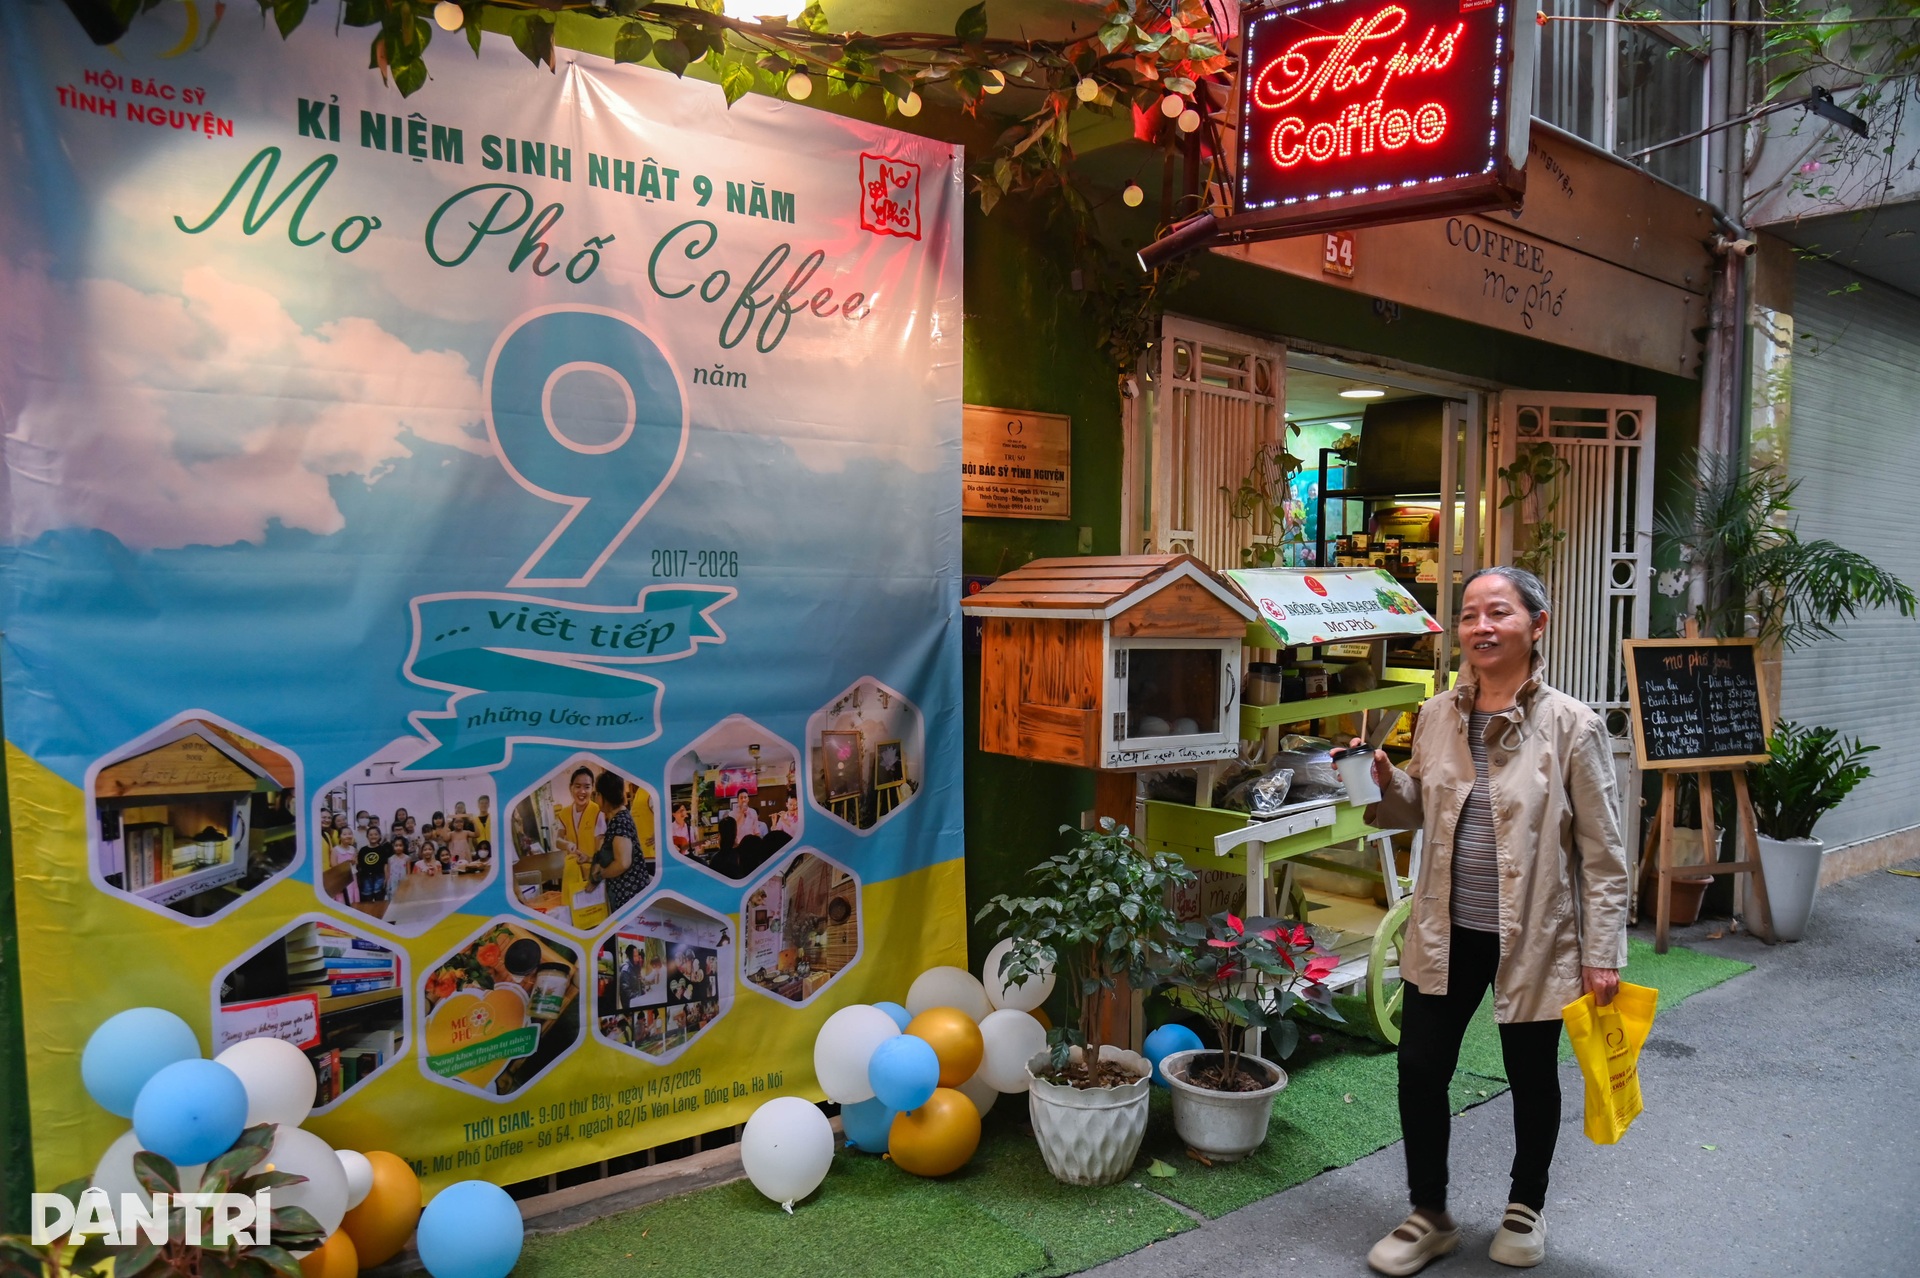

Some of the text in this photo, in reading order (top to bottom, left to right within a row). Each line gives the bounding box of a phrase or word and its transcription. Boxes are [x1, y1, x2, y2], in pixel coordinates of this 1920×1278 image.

[56, 84, 234, 139] TÌNH NGUYỆN
[84, 69, 206, 106] HỘI BÁC SỸ
[1270, 98, 1447, 168] Coffee
[298, 95, 795, 224] KỈ NIỆM SINH NHẬT 9 NĂM
[1540, 150, 1574, 200] nguyện
[174, 146, 871, 354] Mơ Phố Coffee
[1326, 234, 1353, 267] 54
[1445, 217, 1545, 275] COFFEE
[1520, 270, 1567, 330] phố
[693, 364, 748, 389] năm
[483, 303, 690, 589] 9
[962, 461, 1064, 484] HỘI BÁC SỸ TÌNH NGUYỆN
[651, 550, 739, 578] 2017-2026
[488, 606, 577, 642] viết
[590, 618, 676, 655] tiếp
[1284, 601, 1322, 616] NÔNG
[1321, 599, 1348, 614] SẢN
[1347, 600, 1381, 614] SẠCH
[1323, 617, 1375, 632] Mơ Phố
[467, 706, 644, 728] những Ước mơ...
[433, 1154, 454, 1174] Mơ
[458, 1145, 482, 1168] Phố
[485, 1140, 524, 1162] Coffee
[538, 1128, 553, 1148] Số
[556, 1124, 574, 1144] 54,
[579, 1115, 613, 1138] ngách
[617, 1104, 648, 1128] 82/15
[652, 1102, 669, 1118] Yên
[673, 1096, 700, 1113] Lãng,
[704, 1085, 728, 1106] Đống
[733, 1081, 748, 1098] Đa,
[752, 1076, 764, 1093] Hà
[767, 1070, 783, 1090] Nội
[464, 1116, 494, 1142] THỜI
[499, 1110, 534, 1134] GIAN:
[539, 1102, 565, 1124] 9:00
[569, 1097, 588, 1116] thứ
[618, 1085, 644, 1106] ngày
[647, 1068, 702, 1098] 14/3/2026
